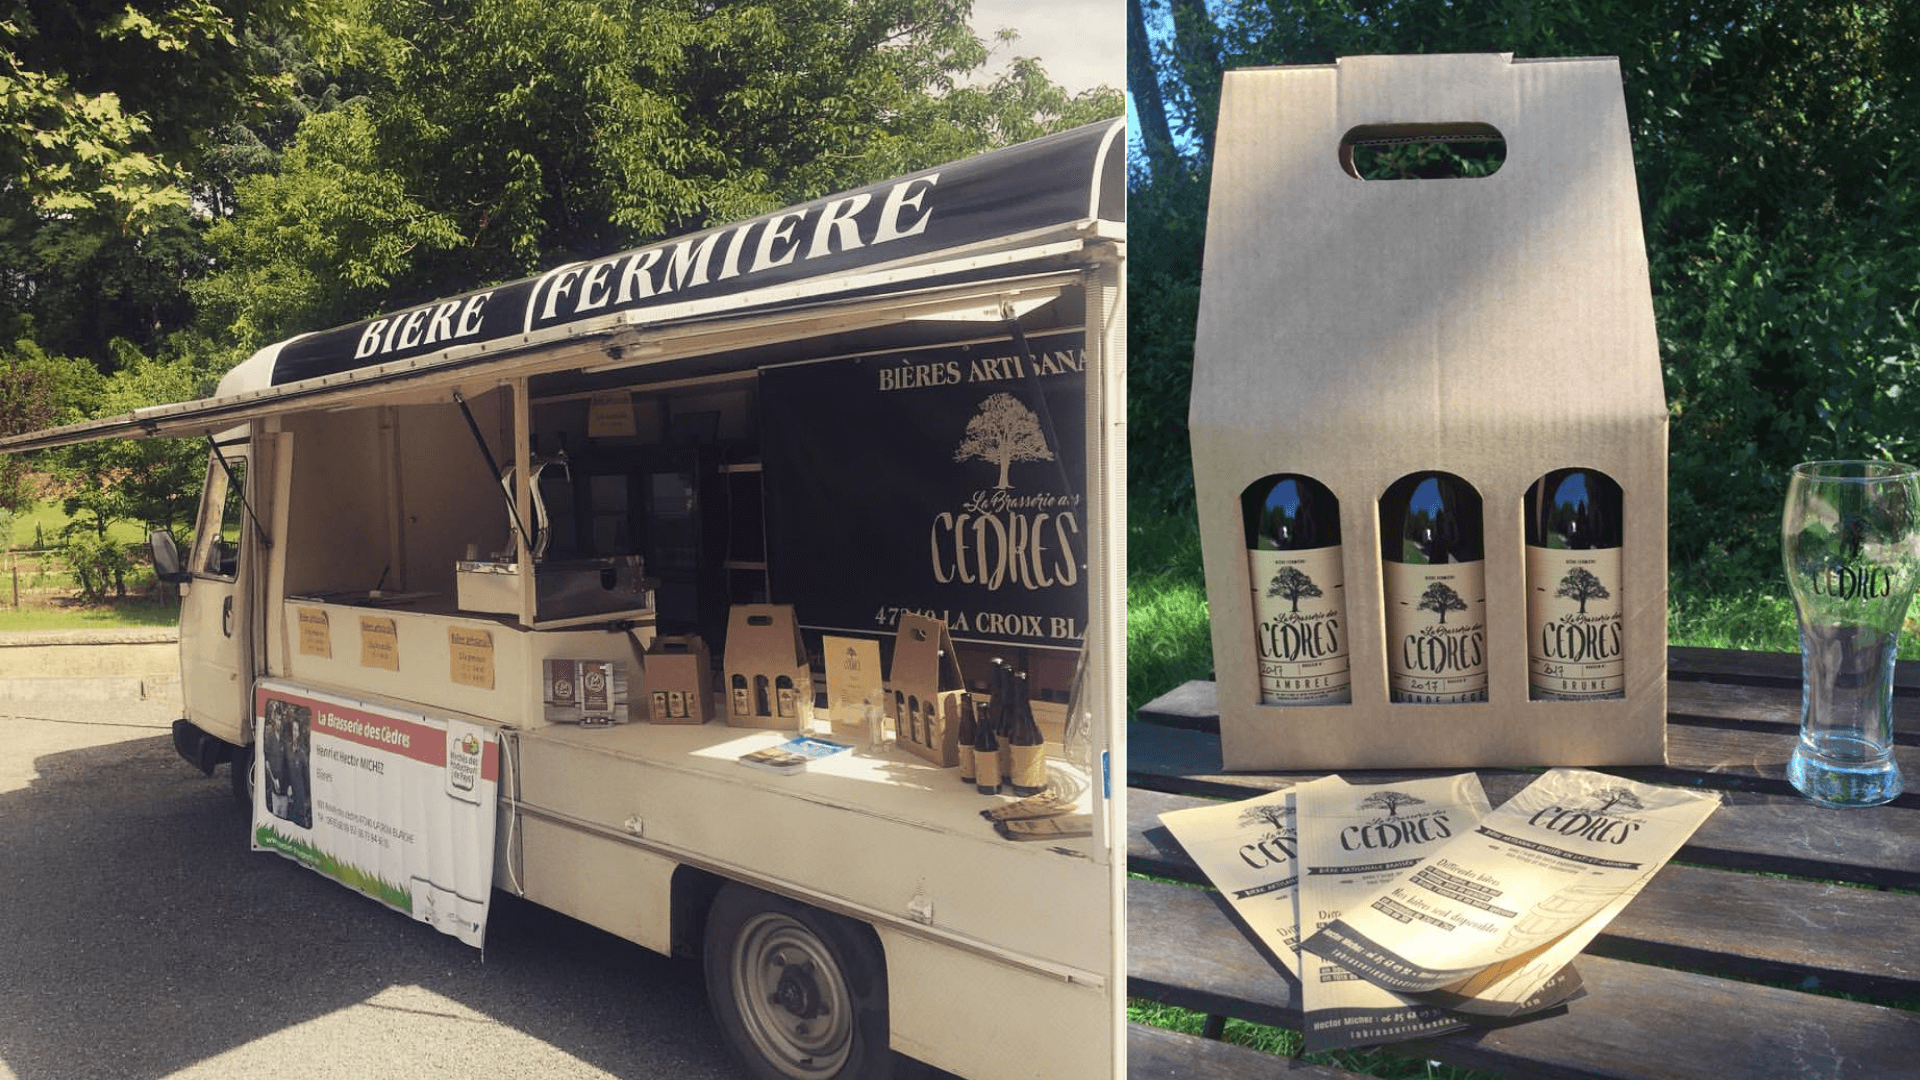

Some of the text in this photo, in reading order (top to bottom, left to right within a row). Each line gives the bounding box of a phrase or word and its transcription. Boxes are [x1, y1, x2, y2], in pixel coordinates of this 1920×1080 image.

[354, 173, 941, 360] BIERE FERMIERE
[878, 359, 962, 391] BIÈRES
[963, 490, 991, 515] La
[991, 489, 1055, 513] Brasserie
[931, 511, 1080, 591] CEDRES
[944, 610, 970, 632] LA
[975, 611, 1044, 637] CROIX
[1049, 616, 1084, 640] BL
[1258, 619, 1339, 662] CEDRES
[1403, 631, 1484, 675] CEDRES
[1543, 621, 1623, 663] CEDRES
[1410, 679, 1438, 692] 2017
[1562, 681, 1606, 690] BRUNE
[318, 709, 327, 727] La
[327, 712, 363, 737] Brasserie
[364, 722, 381, 741] des
[360, 757, 385, 775] MICHEZ
[1340, 815, 1452, 852] CEDRES
[1528, 805, 1640, 845] CEDRES
[1314, 1018, 1341, 1031] Hector
